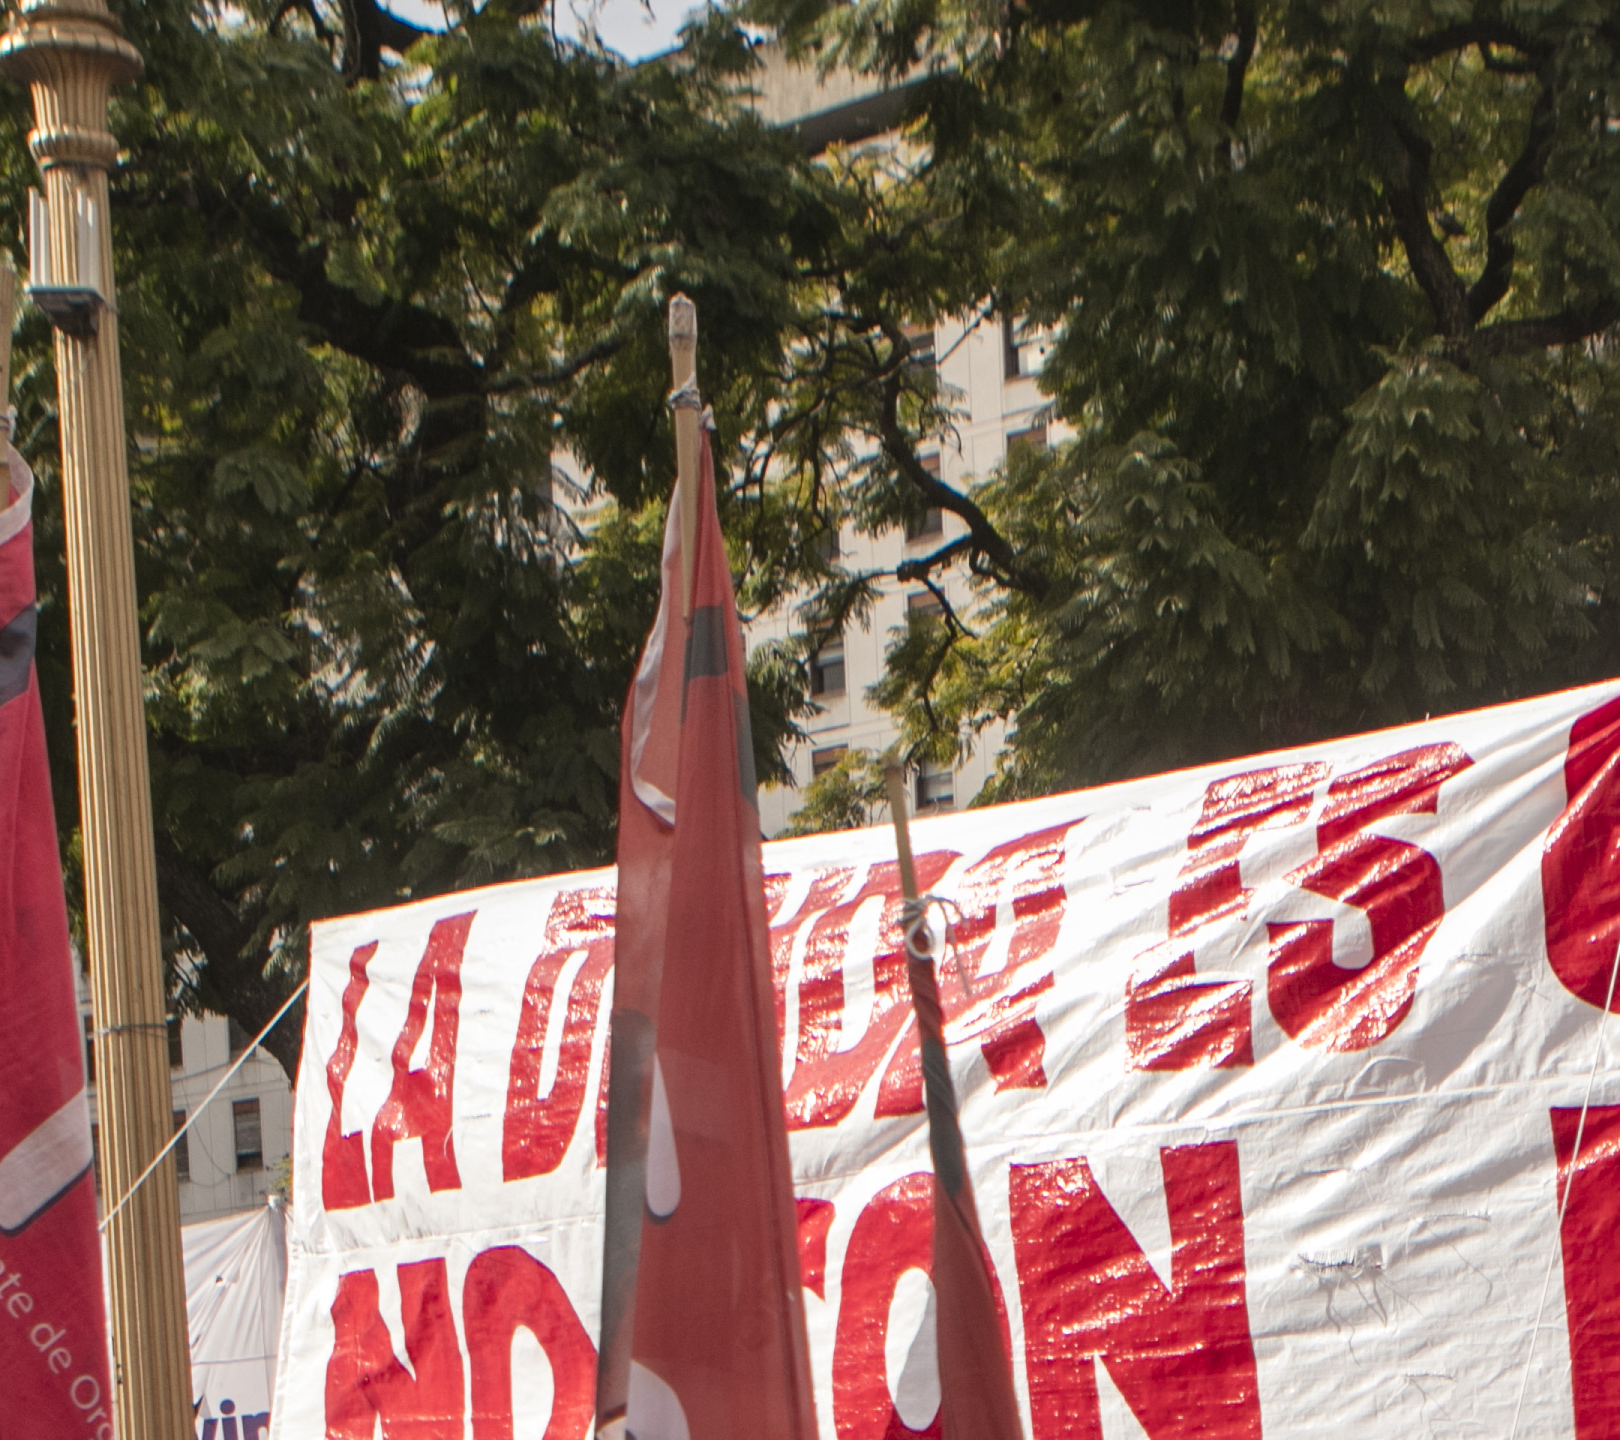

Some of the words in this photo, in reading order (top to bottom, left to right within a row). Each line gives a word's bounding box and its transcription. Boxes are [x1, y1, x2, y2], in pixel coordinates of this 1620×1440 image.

[320, 910, 463, 1212] LA
[1126, 741, 1479, 1072] ES
[30, 1322, 73, 1375] de
